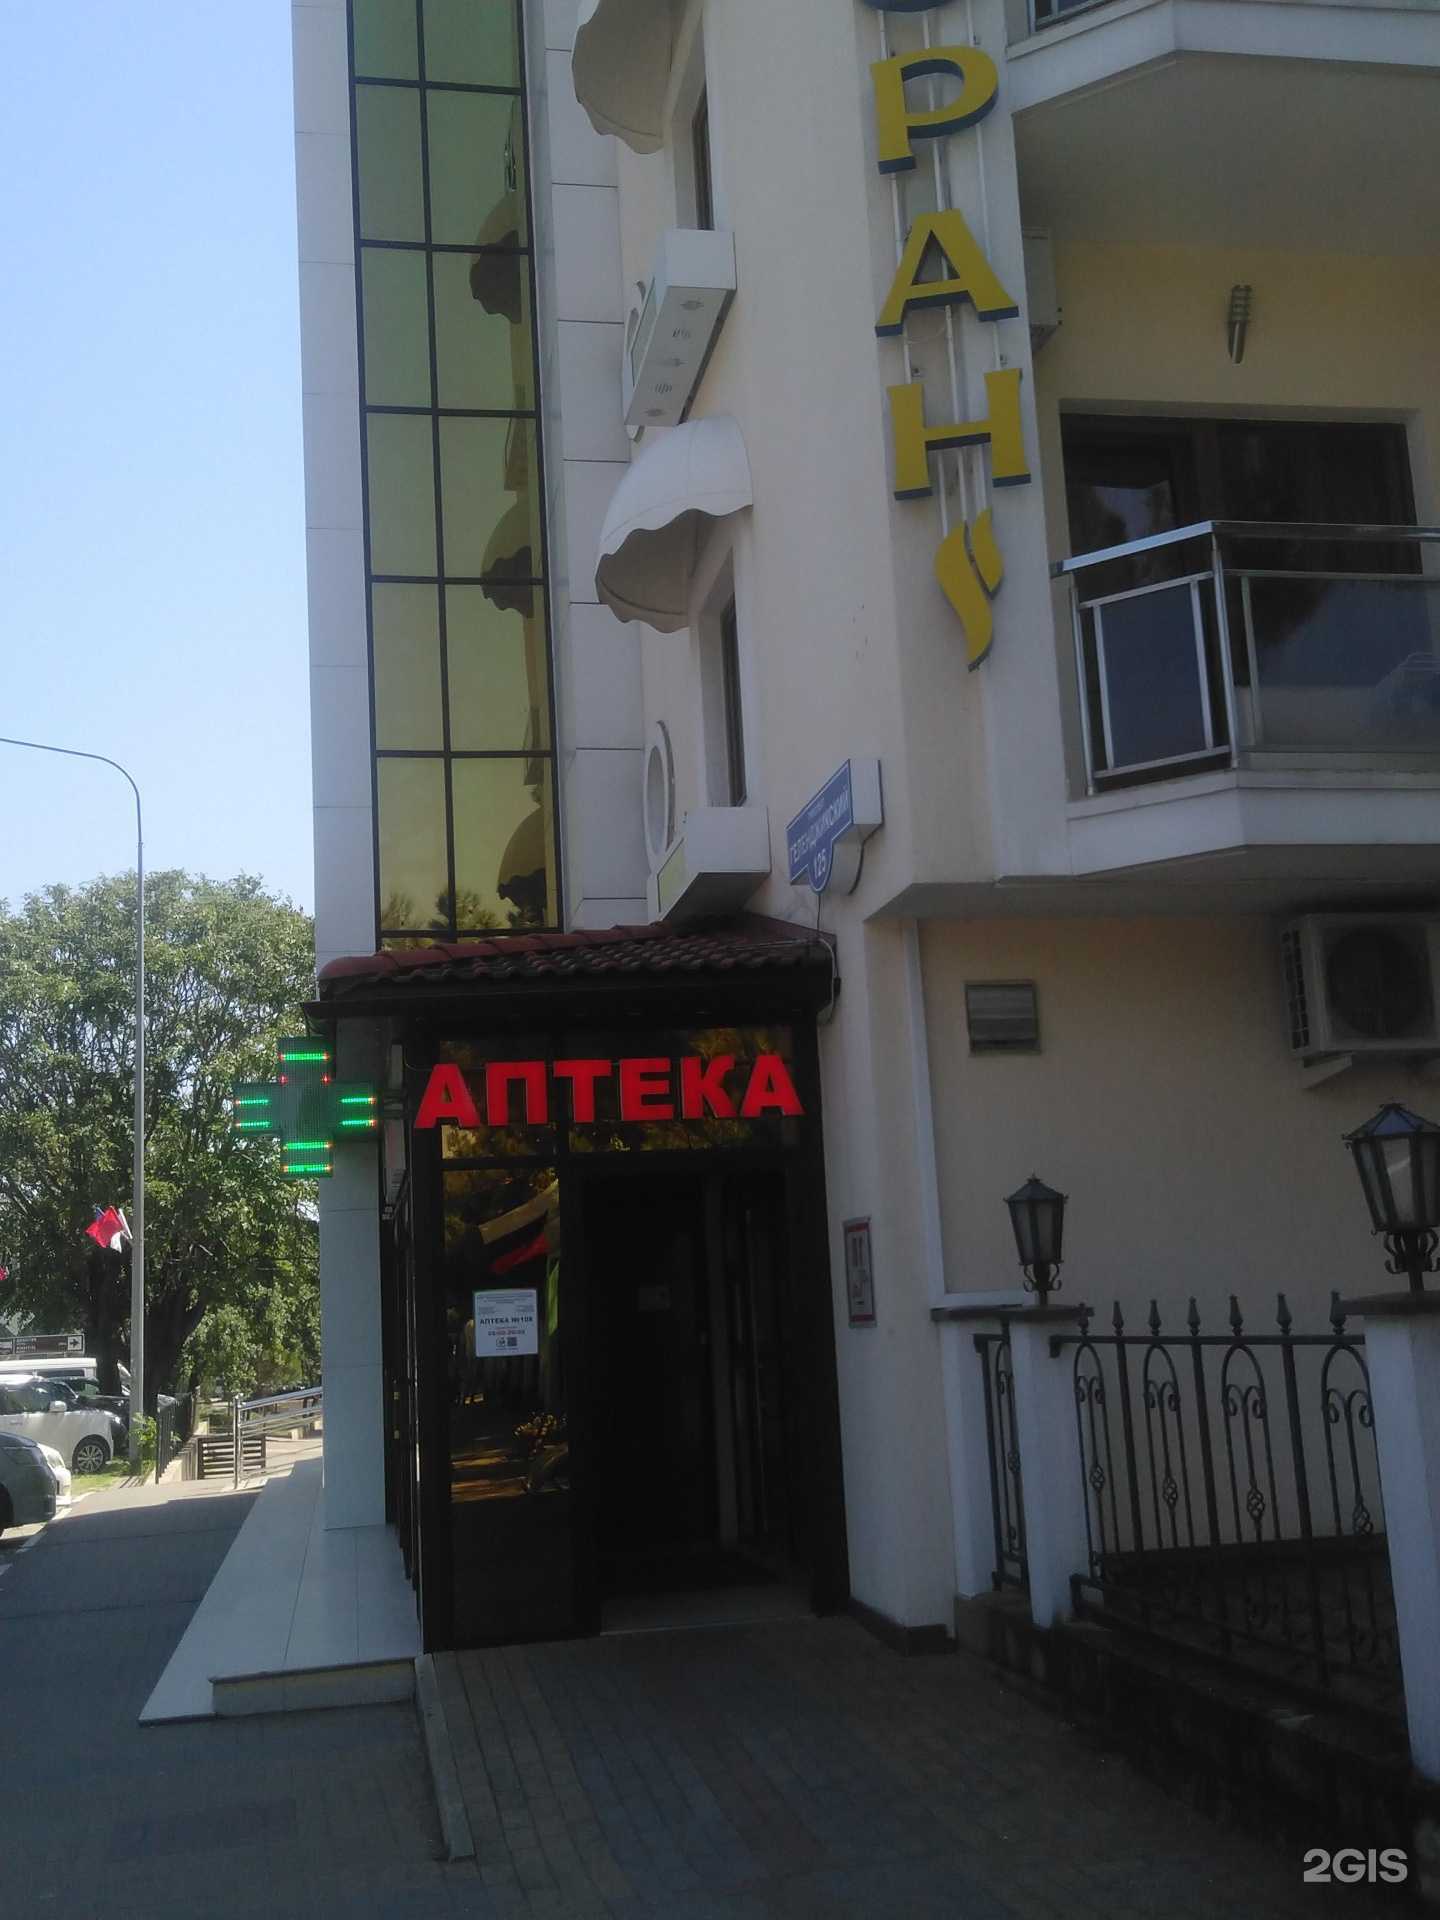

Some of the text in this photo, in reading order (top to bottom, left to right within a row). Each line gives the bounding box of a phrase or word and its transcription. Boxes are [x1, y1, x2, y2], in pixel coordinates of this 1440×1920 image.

[862, 0, 1032, 501] РАН
[814, 848, 826, 880] 125
[413, 1055, 804, 1129] АПТЕКА
[480, 1317, 509, 1325] АПТЕКА
